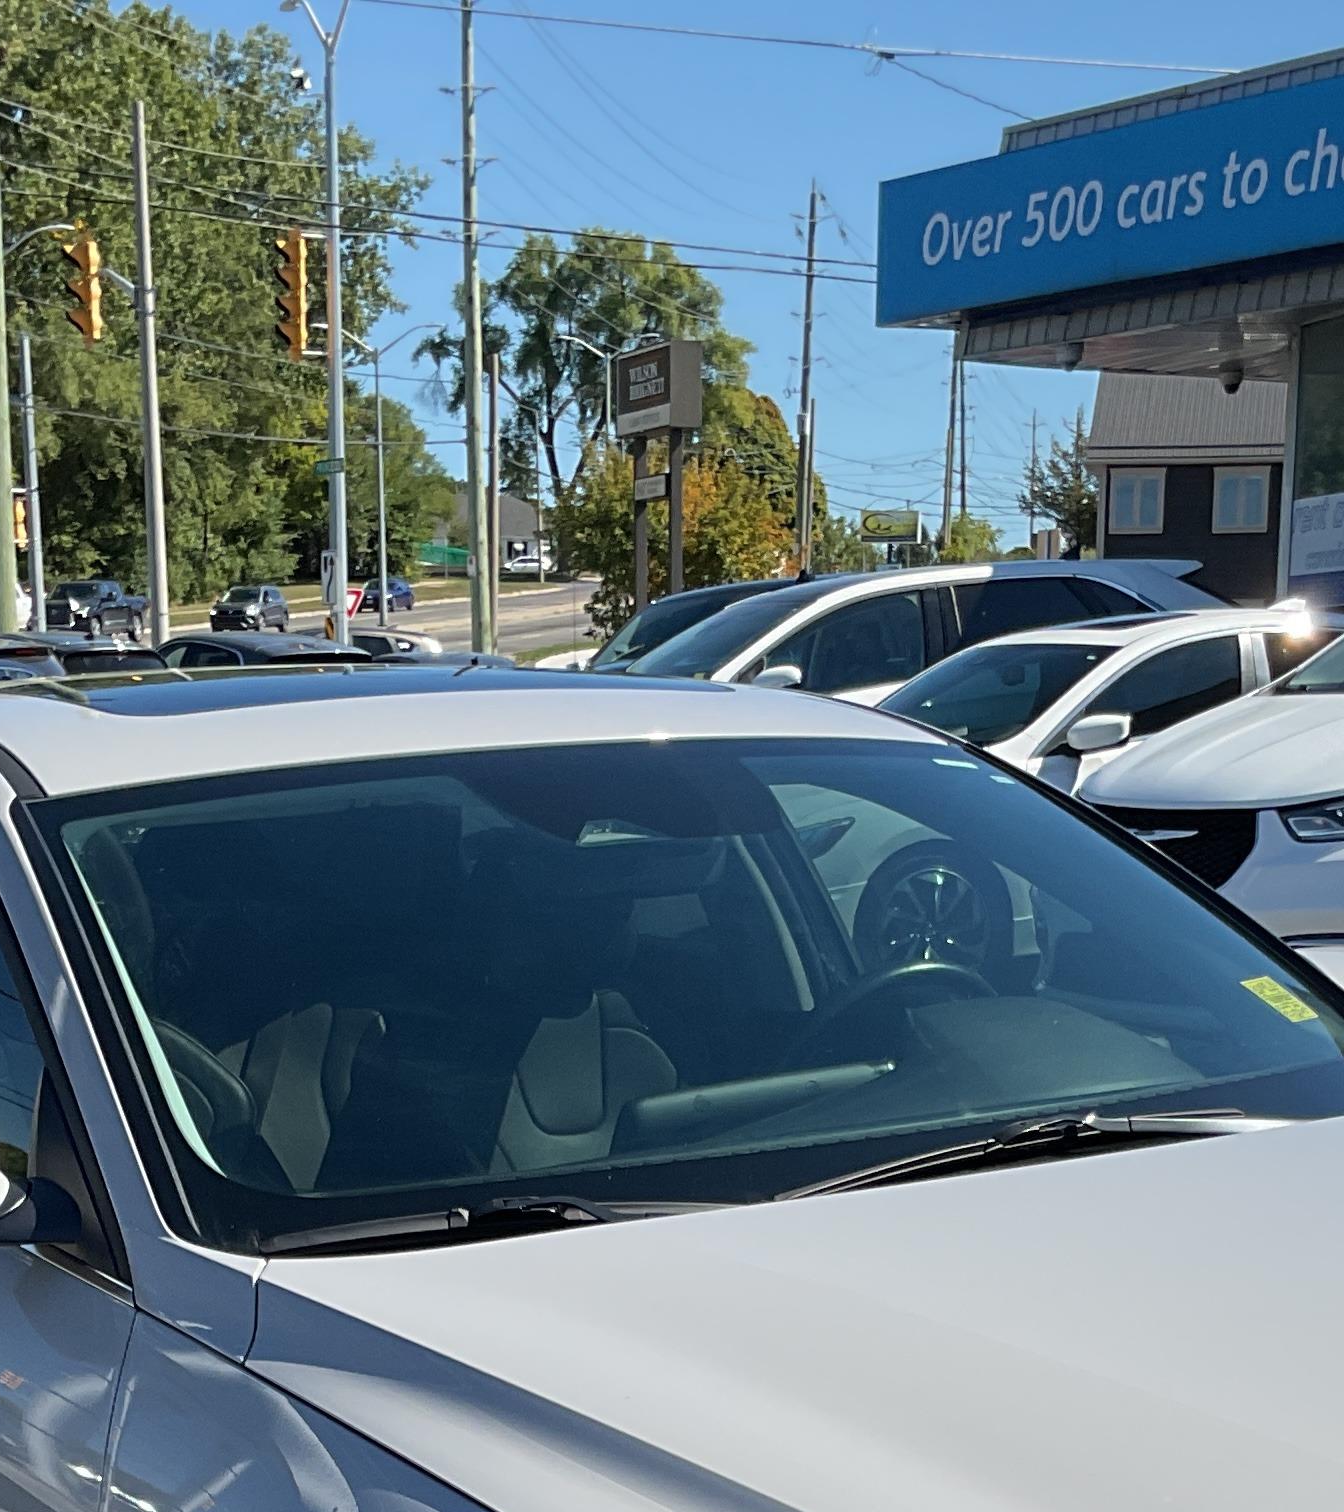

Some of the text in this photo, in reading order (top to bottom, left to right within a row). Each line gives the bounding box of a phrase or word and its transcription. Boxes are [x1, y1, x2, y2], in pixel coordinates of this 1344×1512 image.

[922, 209, 1013, 266] Over
[1021, 180, 1104, 248] 500
[1117, 171, 1207, 229] cars
[1222, 150, 1269, 209] to
